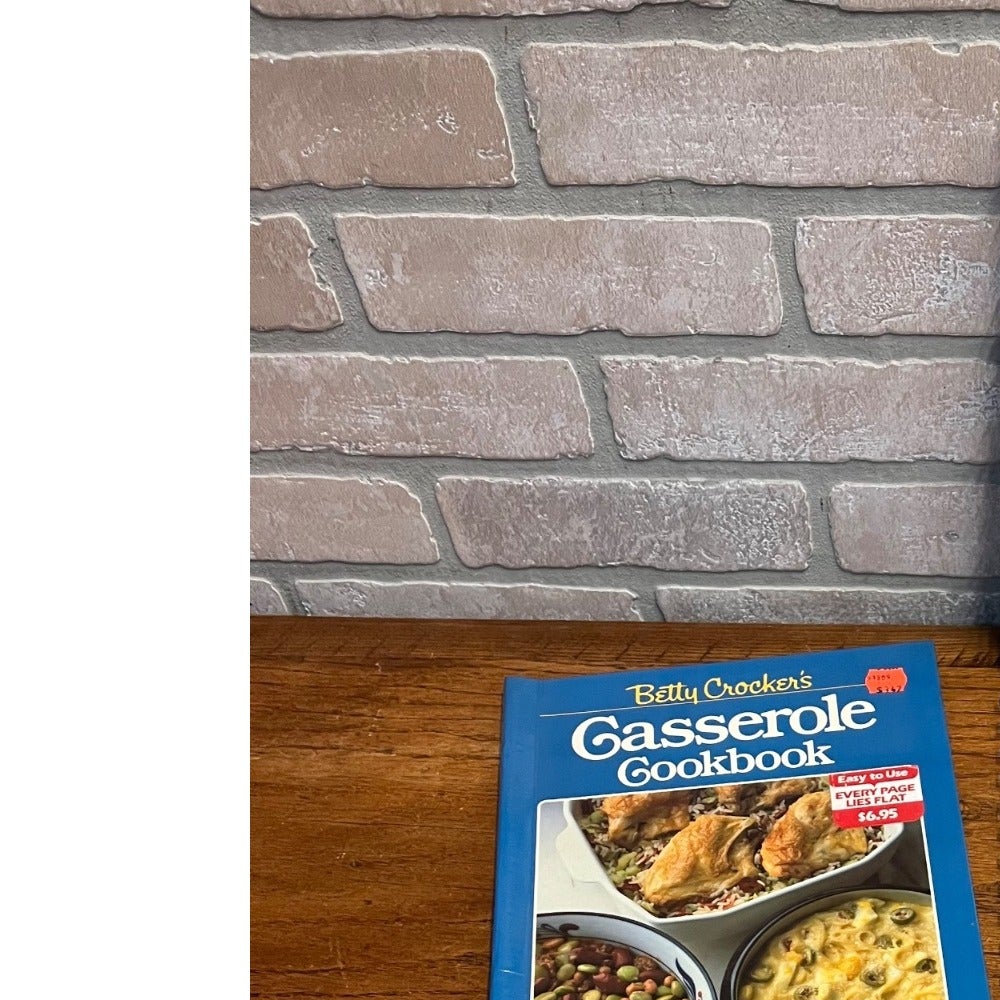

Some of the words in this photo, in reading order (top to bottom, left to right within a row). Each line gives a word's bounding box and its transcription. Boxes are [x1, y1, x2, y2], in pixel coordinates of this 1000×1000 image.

[625, 681, 698, 705] Betty
[703, 670, 812, 700] Crocker's
[571, 693, 877, 761] Casserole
[617, 739, 835, 787] Cookbook
[837, 772, 867, 785] Easy
[870, 771, 883, 781] to
[885, 768, 909, 779] Use
[835, 787, 877, 800] EVERY
[880, 783, 915, 795] PAGE
[846, 797, 871, 808] LIES
[874, 794, 906, 805] FLAT
[858, 808, 898, 822] $6.95
